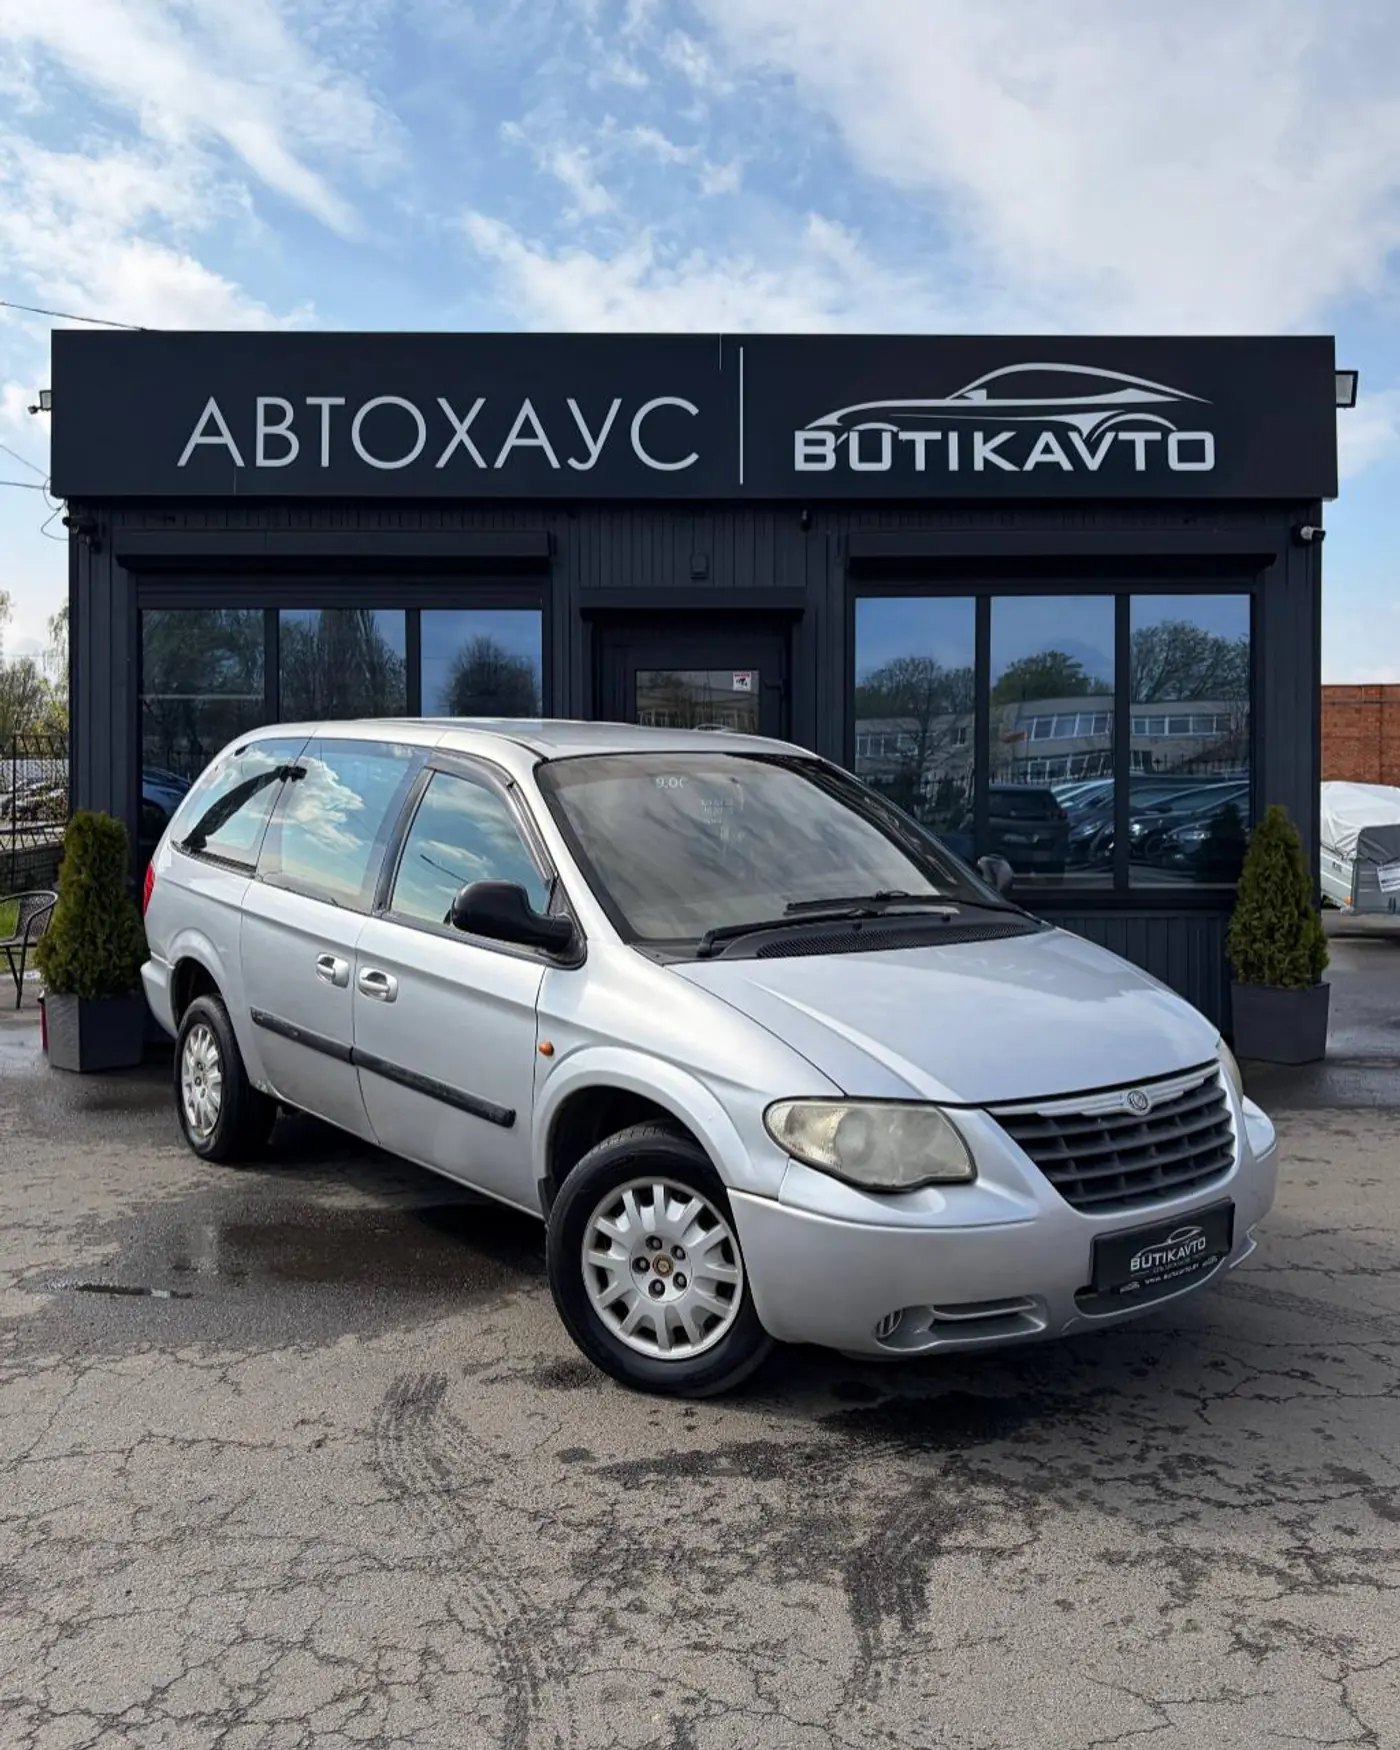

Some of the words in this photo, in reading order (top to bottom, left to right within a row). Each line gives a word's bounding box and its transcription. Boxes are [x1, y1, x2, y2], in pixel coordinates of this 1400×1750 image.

[177, 395, 700, 471] АВТОХАУС
[793, 429, 1216, 472] BUTIKAVTO
[1130, 1236, 1206, 1271] BUTIKAVTO
